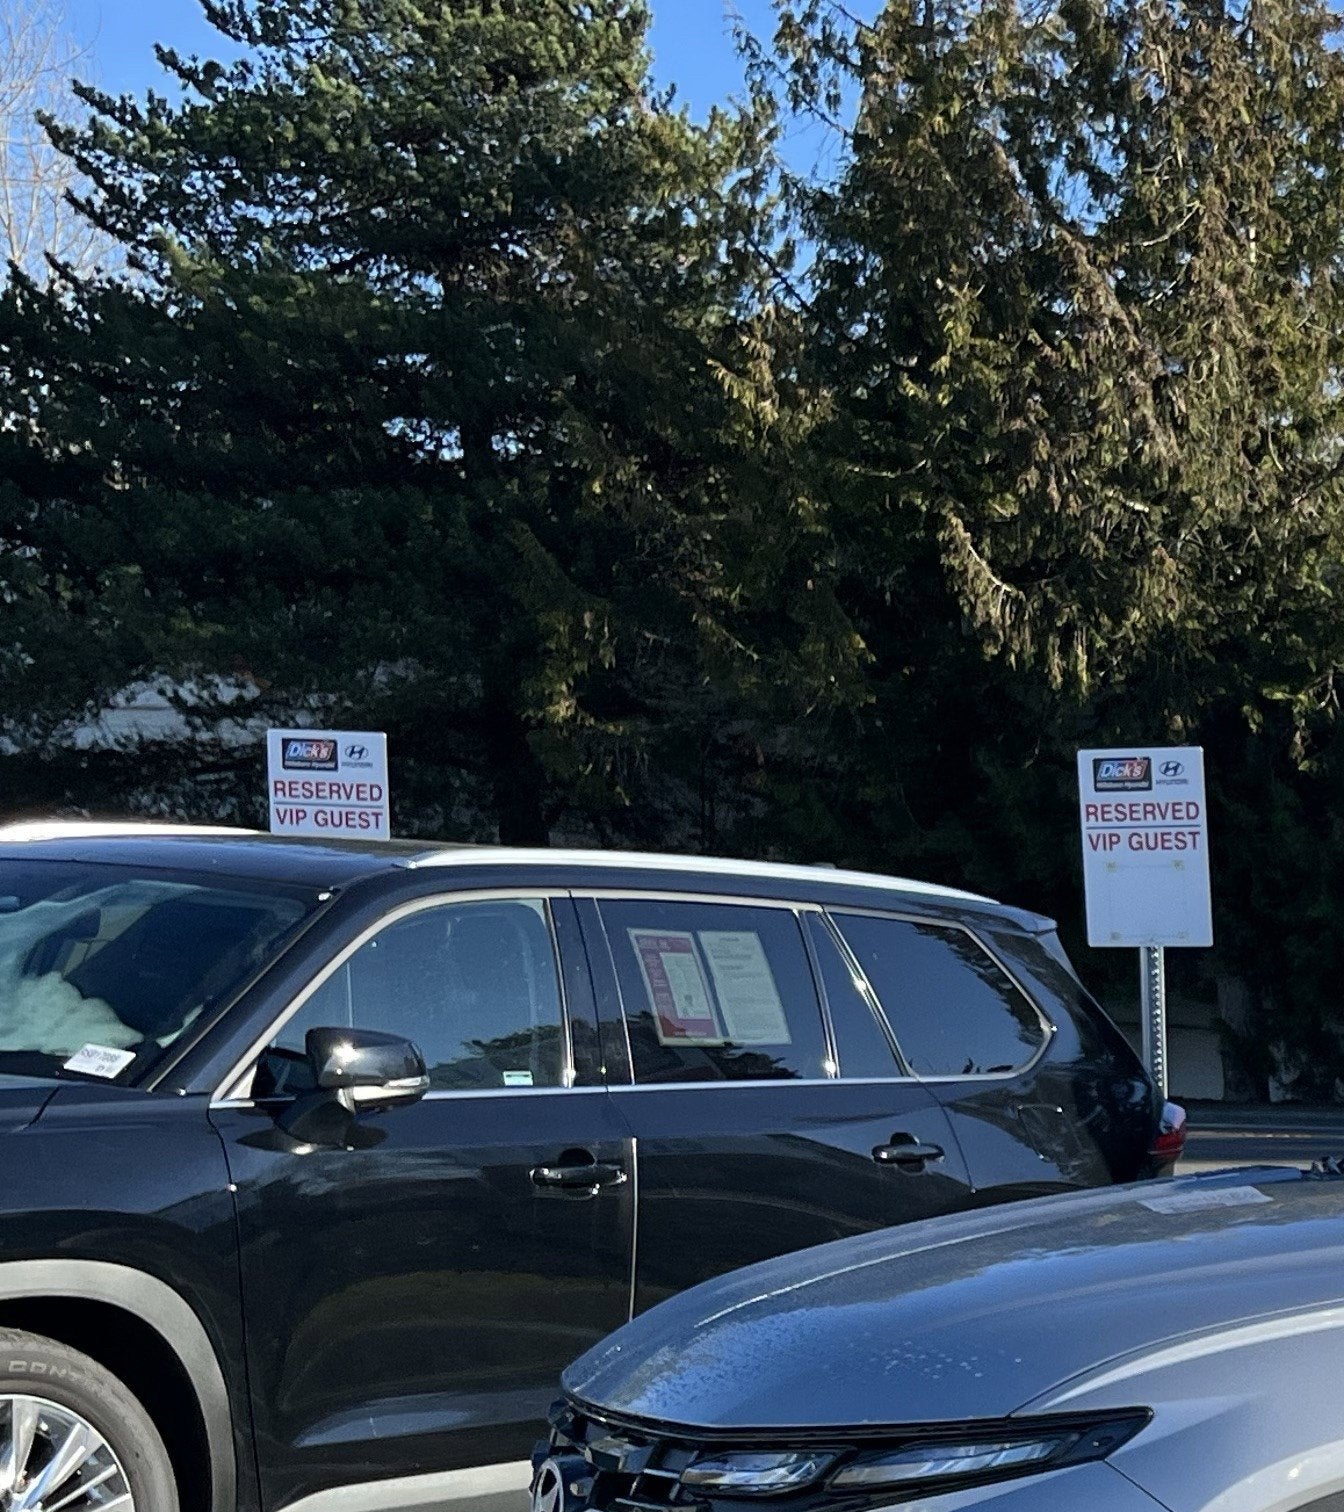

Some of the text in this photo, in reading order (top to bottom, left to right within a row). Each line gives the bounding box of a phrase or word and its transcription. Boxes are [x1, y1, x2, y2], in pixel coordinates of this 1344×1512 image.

[273, 780, 383, 802] RESERVED
[275, 808, 383, 829] VIP GUEST
[1085, 801, 1200, 823] RESERVED
[1088, 831, 1201, 852] VIP GUEST
